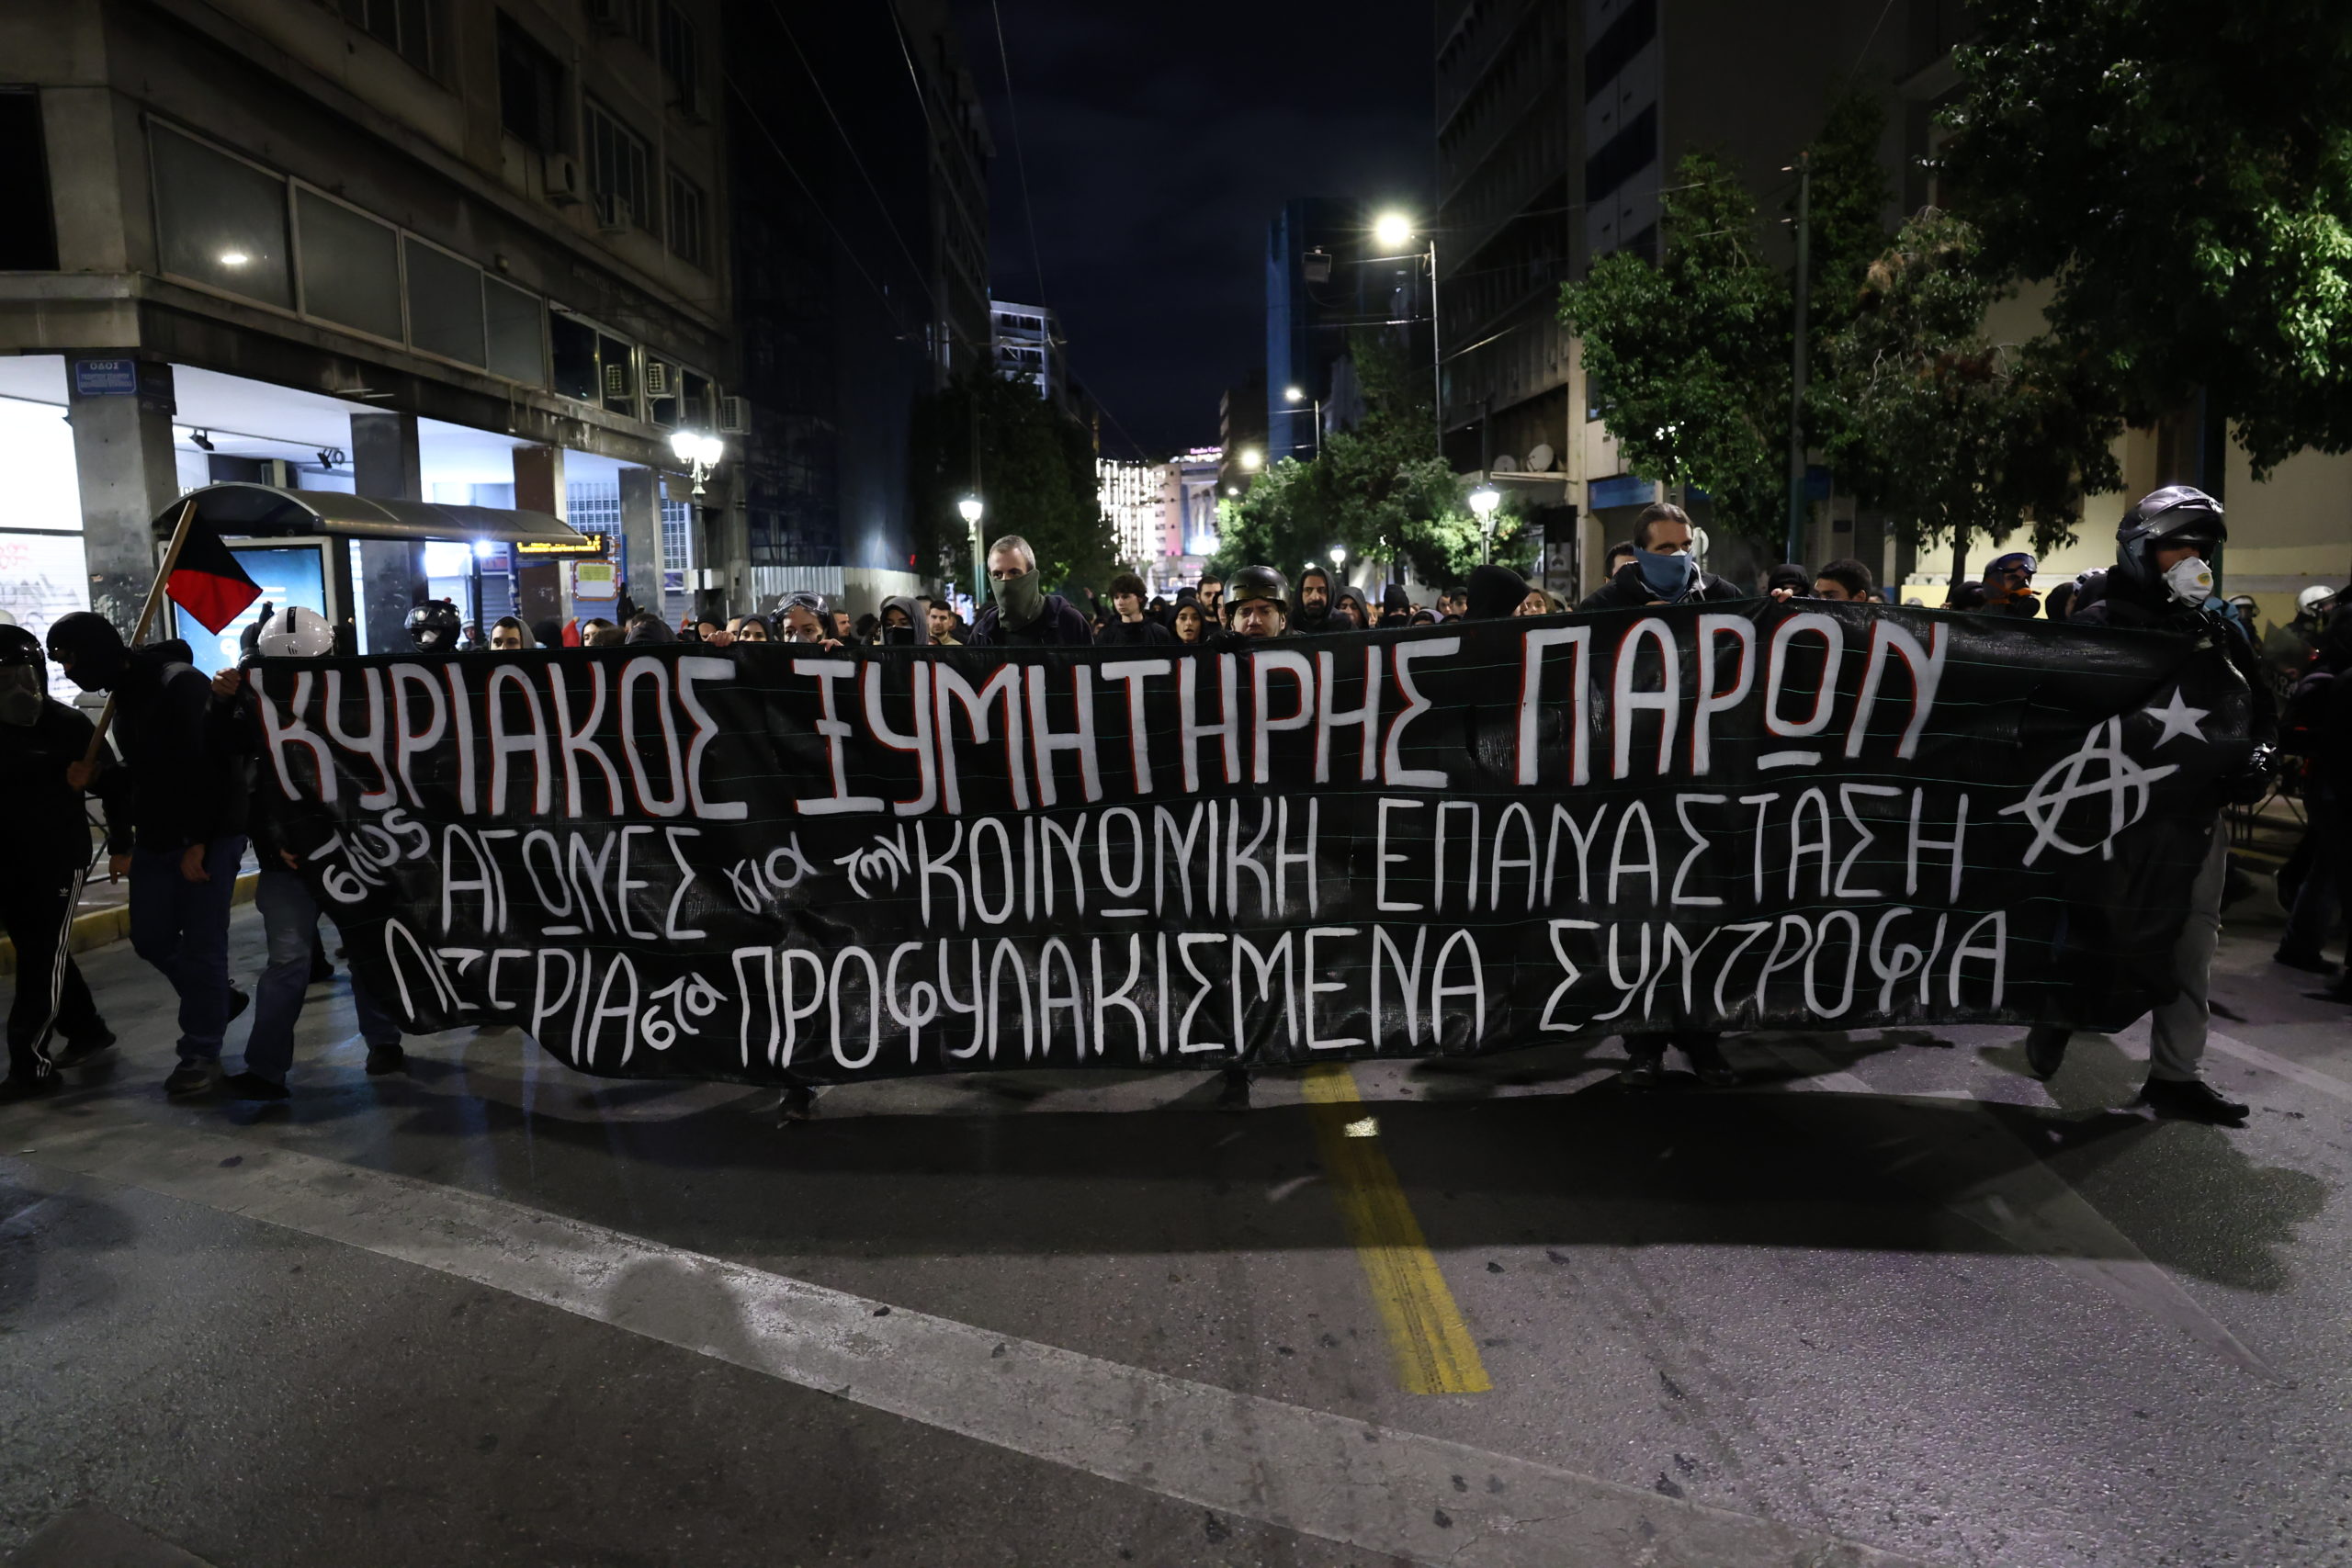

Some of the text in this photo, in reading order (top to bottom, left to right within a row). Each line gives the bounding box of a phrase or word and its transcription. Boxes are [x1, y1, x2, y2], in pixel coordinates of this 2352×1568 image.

[90, 362, 119, 370] ΟΔΟΣ
[247, 656, 747, 819] ΚΥΡΙΑΚΟΣ
[791, 637, 1461, 817] ΞΥΜΗΤΗΡΗΣ
[724, 831, 818, 914] για
[834, 823, 912, 899] την
[1378, 784, 1969, 915] ΕΠΑΝΑΣΤΑΣΗ
[640, 972, 728, 1050] στα
[732, 924, 1485, 1068] ΠΡΟΦΥΛΑΚΙΣΜΕΝΑ
[1540, 908, 2006, 1032] ΣΥΝΤΡΟΦΙΑ
